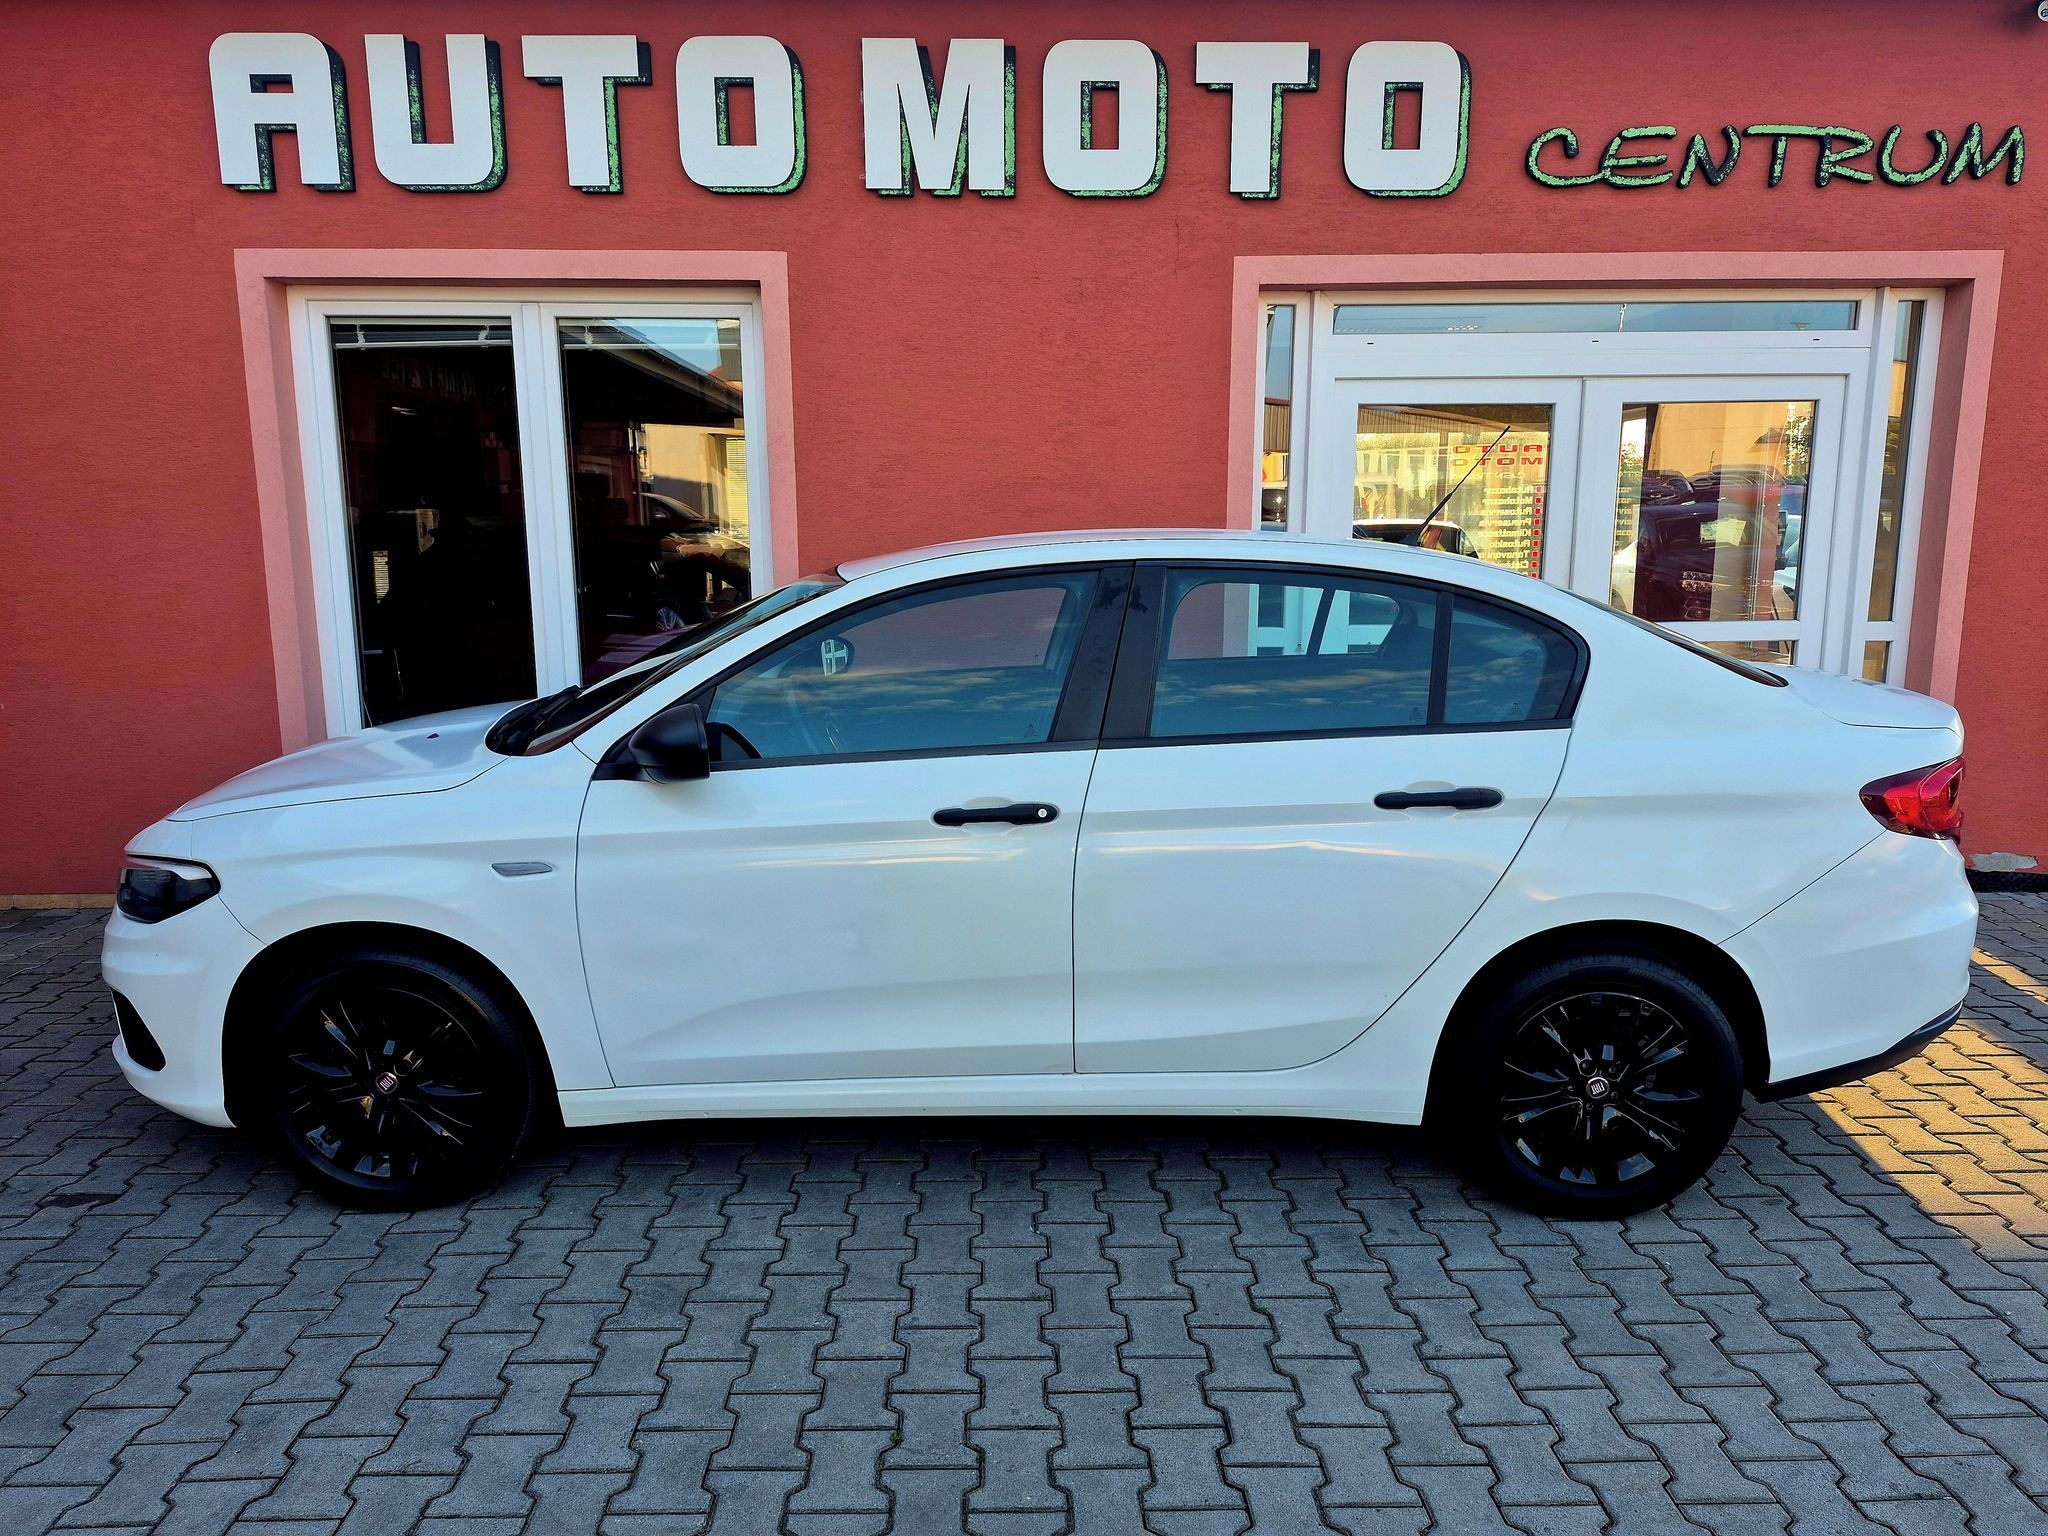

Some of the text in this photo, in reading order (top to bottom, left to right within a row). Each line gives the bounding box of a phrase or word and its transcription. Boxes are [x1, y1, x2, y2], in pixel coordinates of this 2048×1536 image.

[208, 32, 2026, 199] AUTO MOTO CENTRUM
